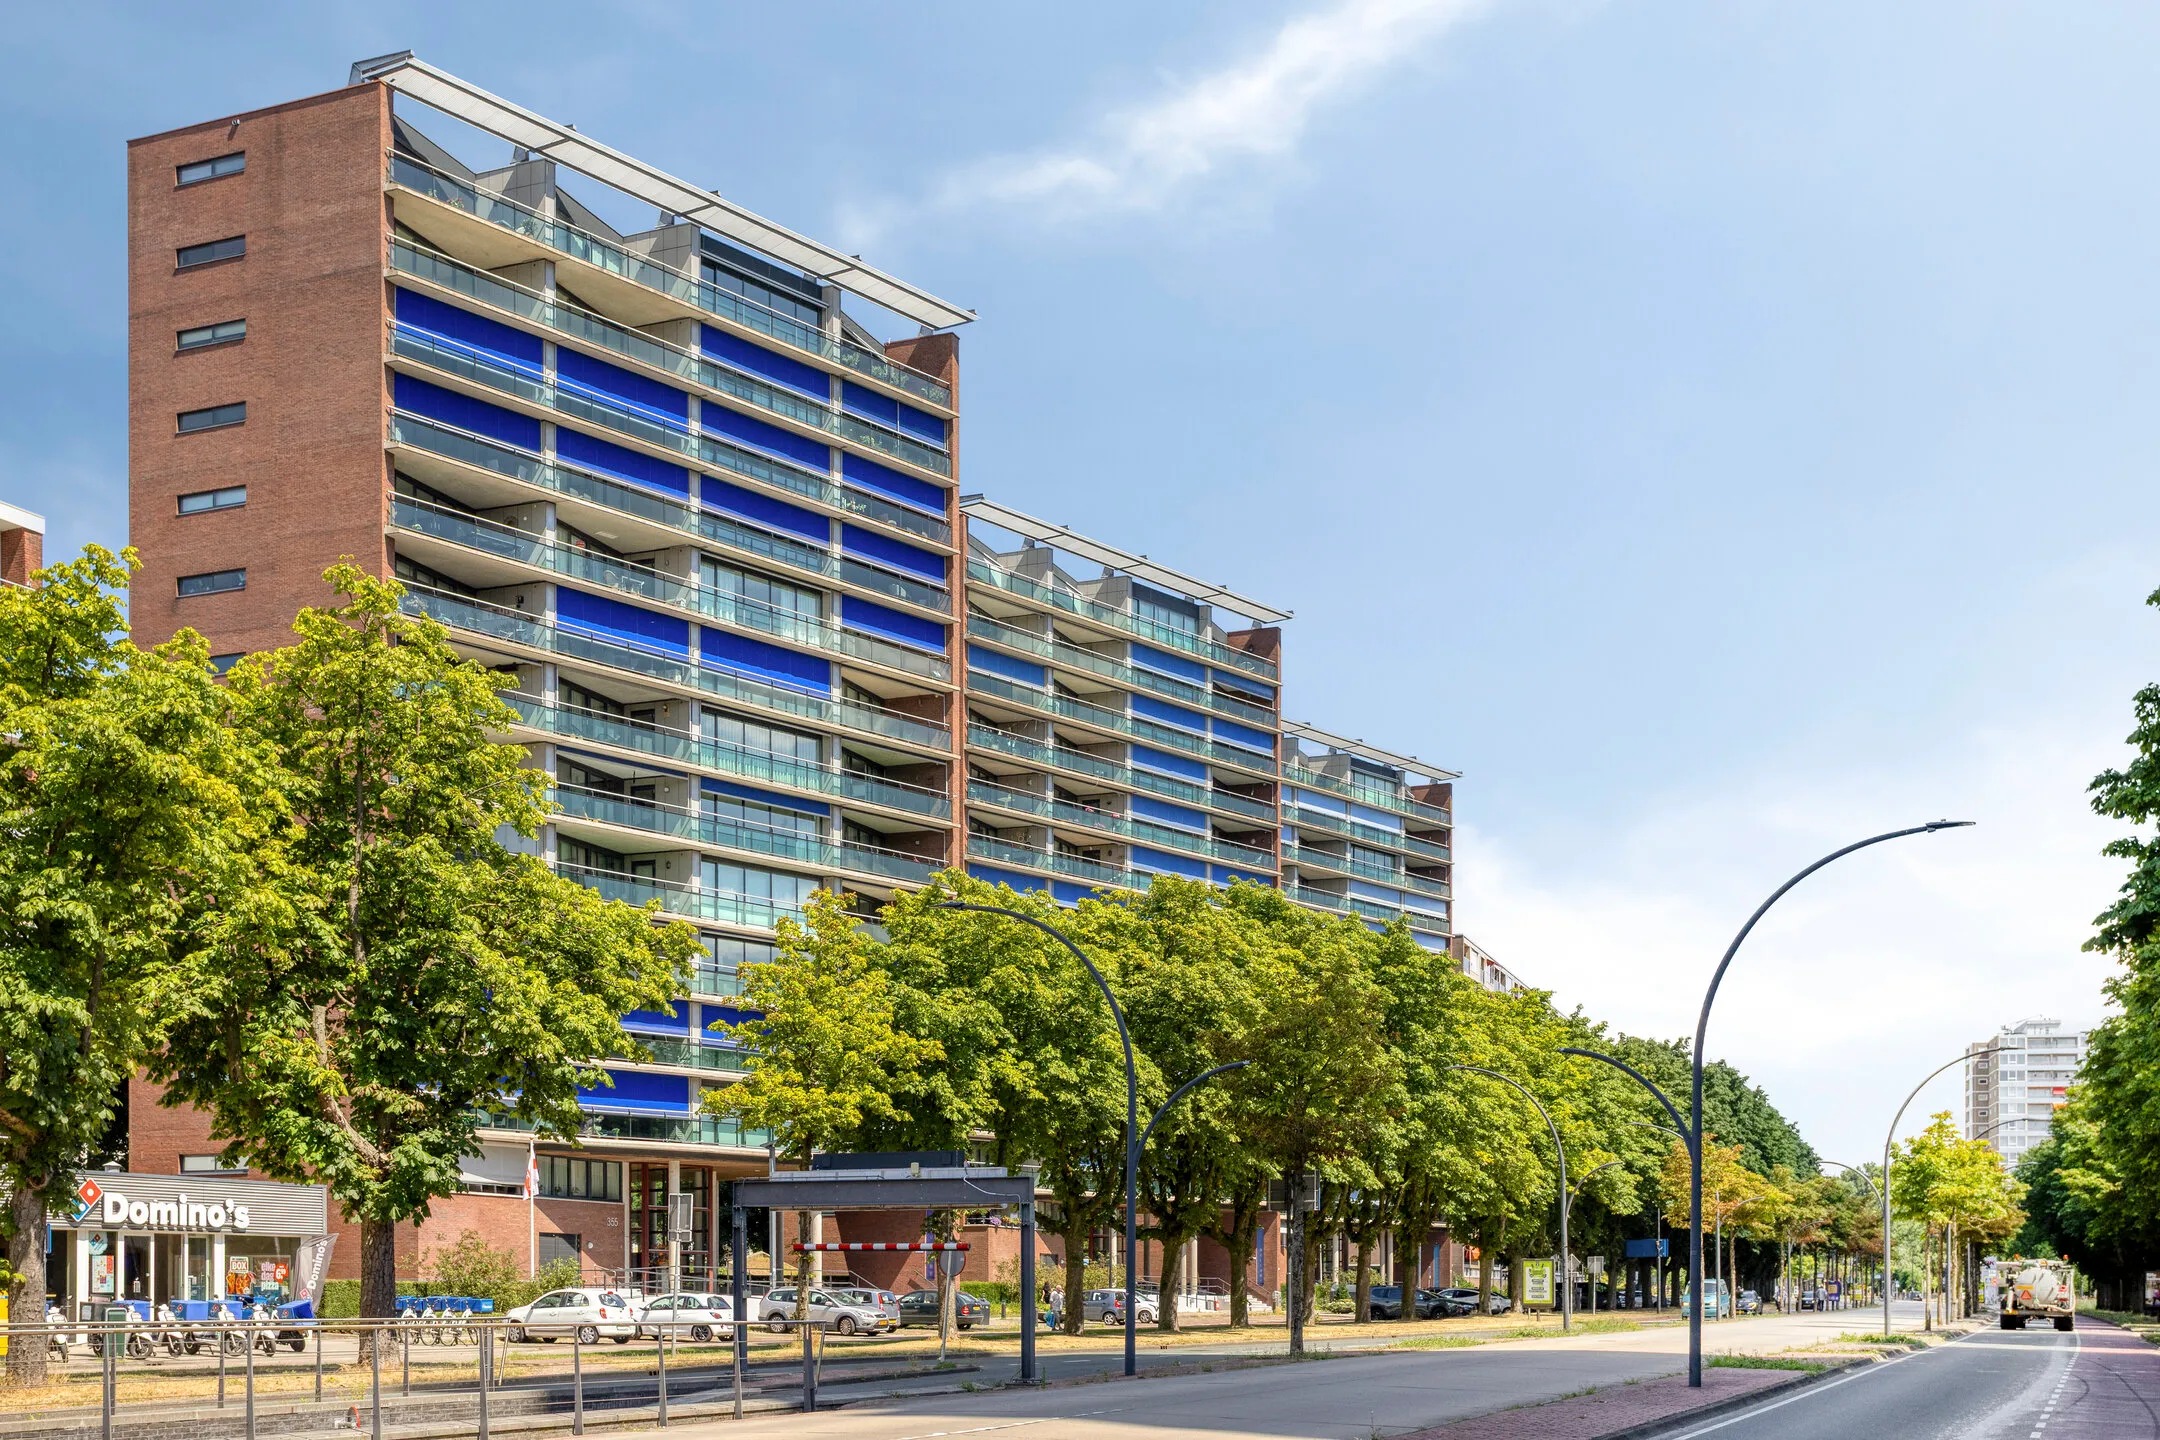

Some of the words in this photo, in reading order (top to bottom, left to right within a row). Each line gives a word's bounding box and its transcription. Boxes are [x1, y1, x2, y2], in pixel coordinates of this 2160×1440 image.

[103, 1192, 250, 1229] Domino's
[232, 1261, 247, 1270] BOX
[306, 1240, 328, 1290] Domino's
[261, 1281, 279, 1291] pizza
